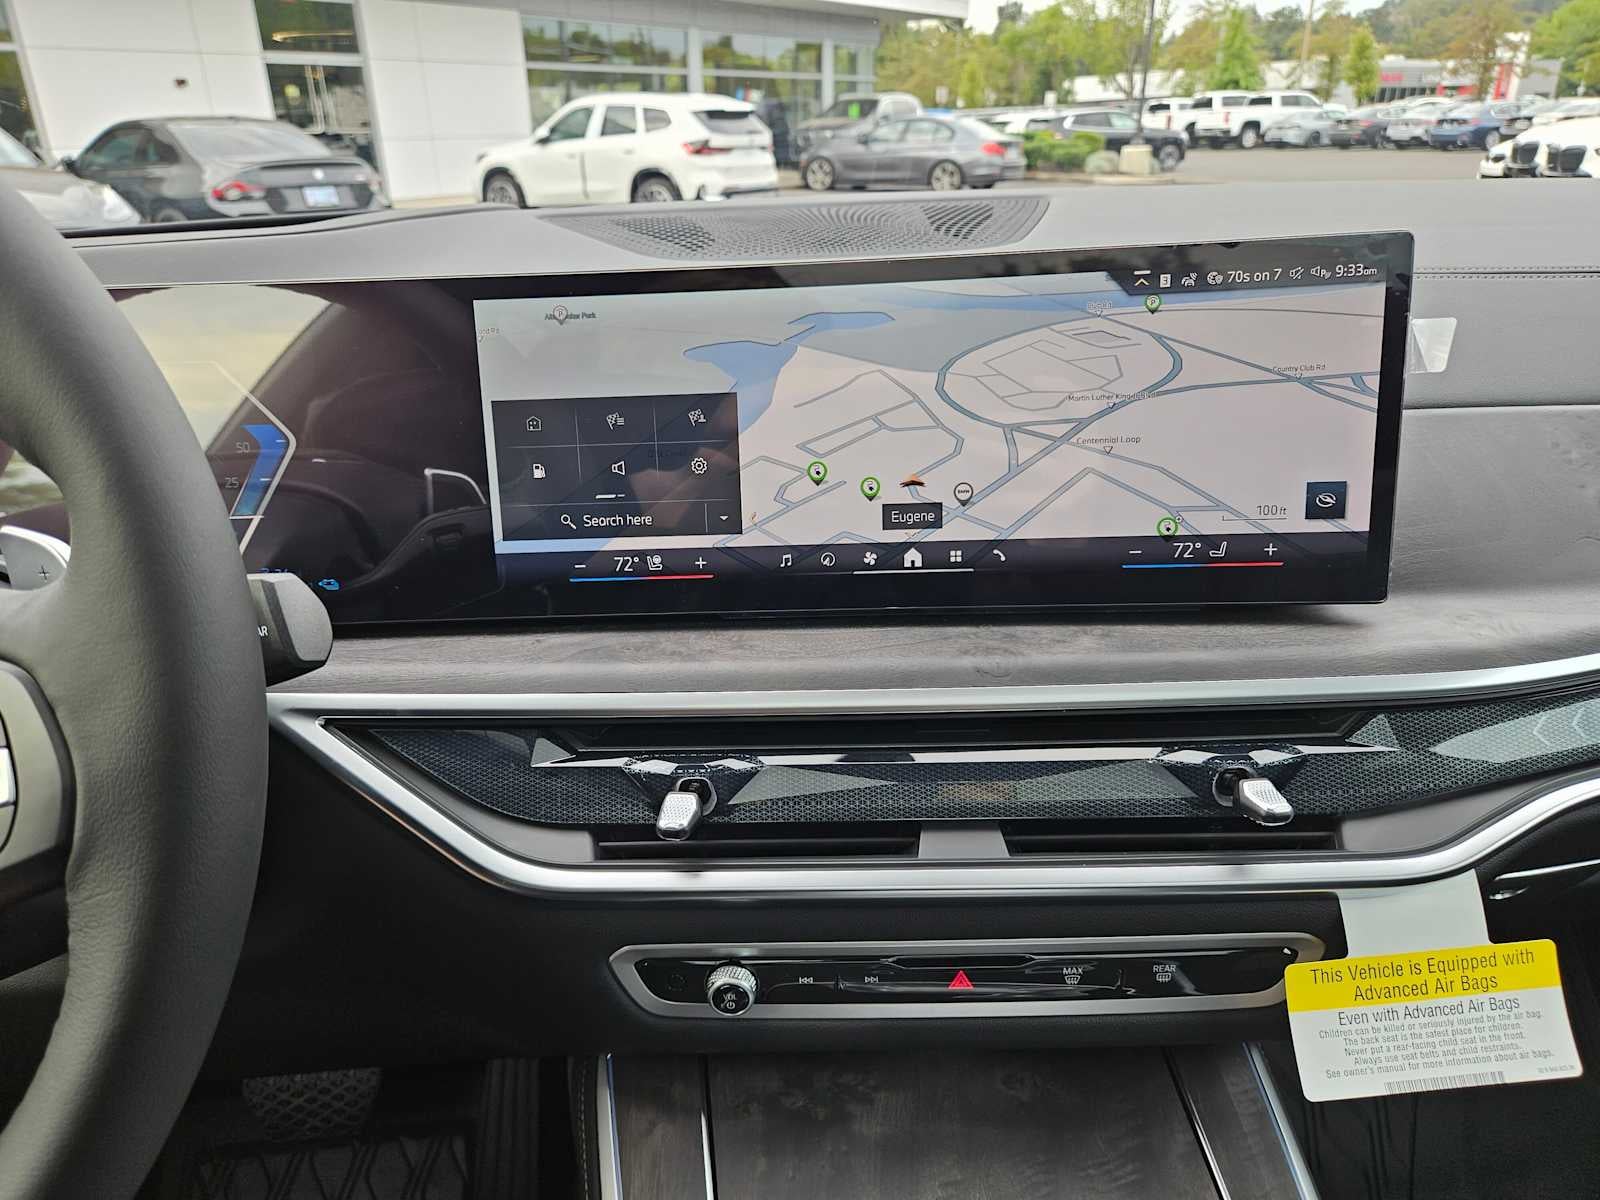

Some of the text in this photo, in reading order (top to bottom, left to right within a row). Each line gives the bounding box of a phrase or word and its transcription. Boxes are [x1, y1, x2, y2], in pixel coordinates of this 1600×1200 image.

[1227, 268, 1282, 283] 70s on 7
[1335, 263, 1377, 277] 9:33am
[1068, 393, 1089, 401] Martin
[1092, 392, 1114, 400] Luther
[236, 442, 250, 453] 50
[1076, 436, 1141, 444] Centennial Loop
[224, 476, 240, 488] 25
[891, 510, 936, 524] Eugene
[1256, 504, 1287, 516] 100 ft
[583, 514, 652, 526] Search here
[1172, 542, 1202, 558] 72°
[614, 556, 640, 572] 72°
[1062, 967, 1084, 976] MAX
[1152, 964, 1177, 972] REAR
[1310, 948, 1535, 984] This Vehicle is Equipped with
[1354, 976, 1498, 1002] Advanced Air Bags
[1338, 997, 1520, 1026] Even with Advanced Air Bags
[1318, 1029, 1353, 1040] Children
[1356, 1028, 1369, 1036] can
[1371, 1026, 1382, 1034] be
[1384, 1024, 1405, 1033] killed
[1418, 1018, 1454, 1030] seriously
[1456, 1015, 1484, 1026] injured
[1486, 1014, 1496, 1024] by
[1498, 1012, 1511, 1022] the
[1514, 1012, 1524, 1020] air
[1344, 1038, 1358, 1046] The
[1360, 1036, 1380, 1045] back
[1382, 1034, 1398, 1043] seat
[1401, 1033, 1408, 1041] is
[1410, 1032, 1423, 1040] the
[1426, 1029, 1448, 1038] safest
[1451, 1026, 1472, 1036] place
[1474, 1026, 1486, 1034] for
[1344, 1048, 1368, 1056] Never
[1370, 1046, 1384, 1055] put
[1438, 1038, 1458, 1048] child
[1460, 1036, 1476, 1045] seat
[1480, 1035, 1486, 1043] in
[1488, 1033, 1502, 1042] the
[1354, 1056, 1382, 1066] Always
[1384, 1054, 1398, 1063] use
[1401, 1052, 1418, 1061] seat
[1420, 1050, 1440, 1060] belts
[1442, 1048, 1456, 1057] and
[1459, 1046, 1478, 1056] child
[1326, 1069, 1340, 1079] See
[1376, 1063, 1406, 1074] manual
[1408, 1062, 1420, 1070] for
[1422, 1060, 1443, 1069] more
[1446, 1055, 1492, 1067] information
[1494, 1052, 1518, 1062] about
